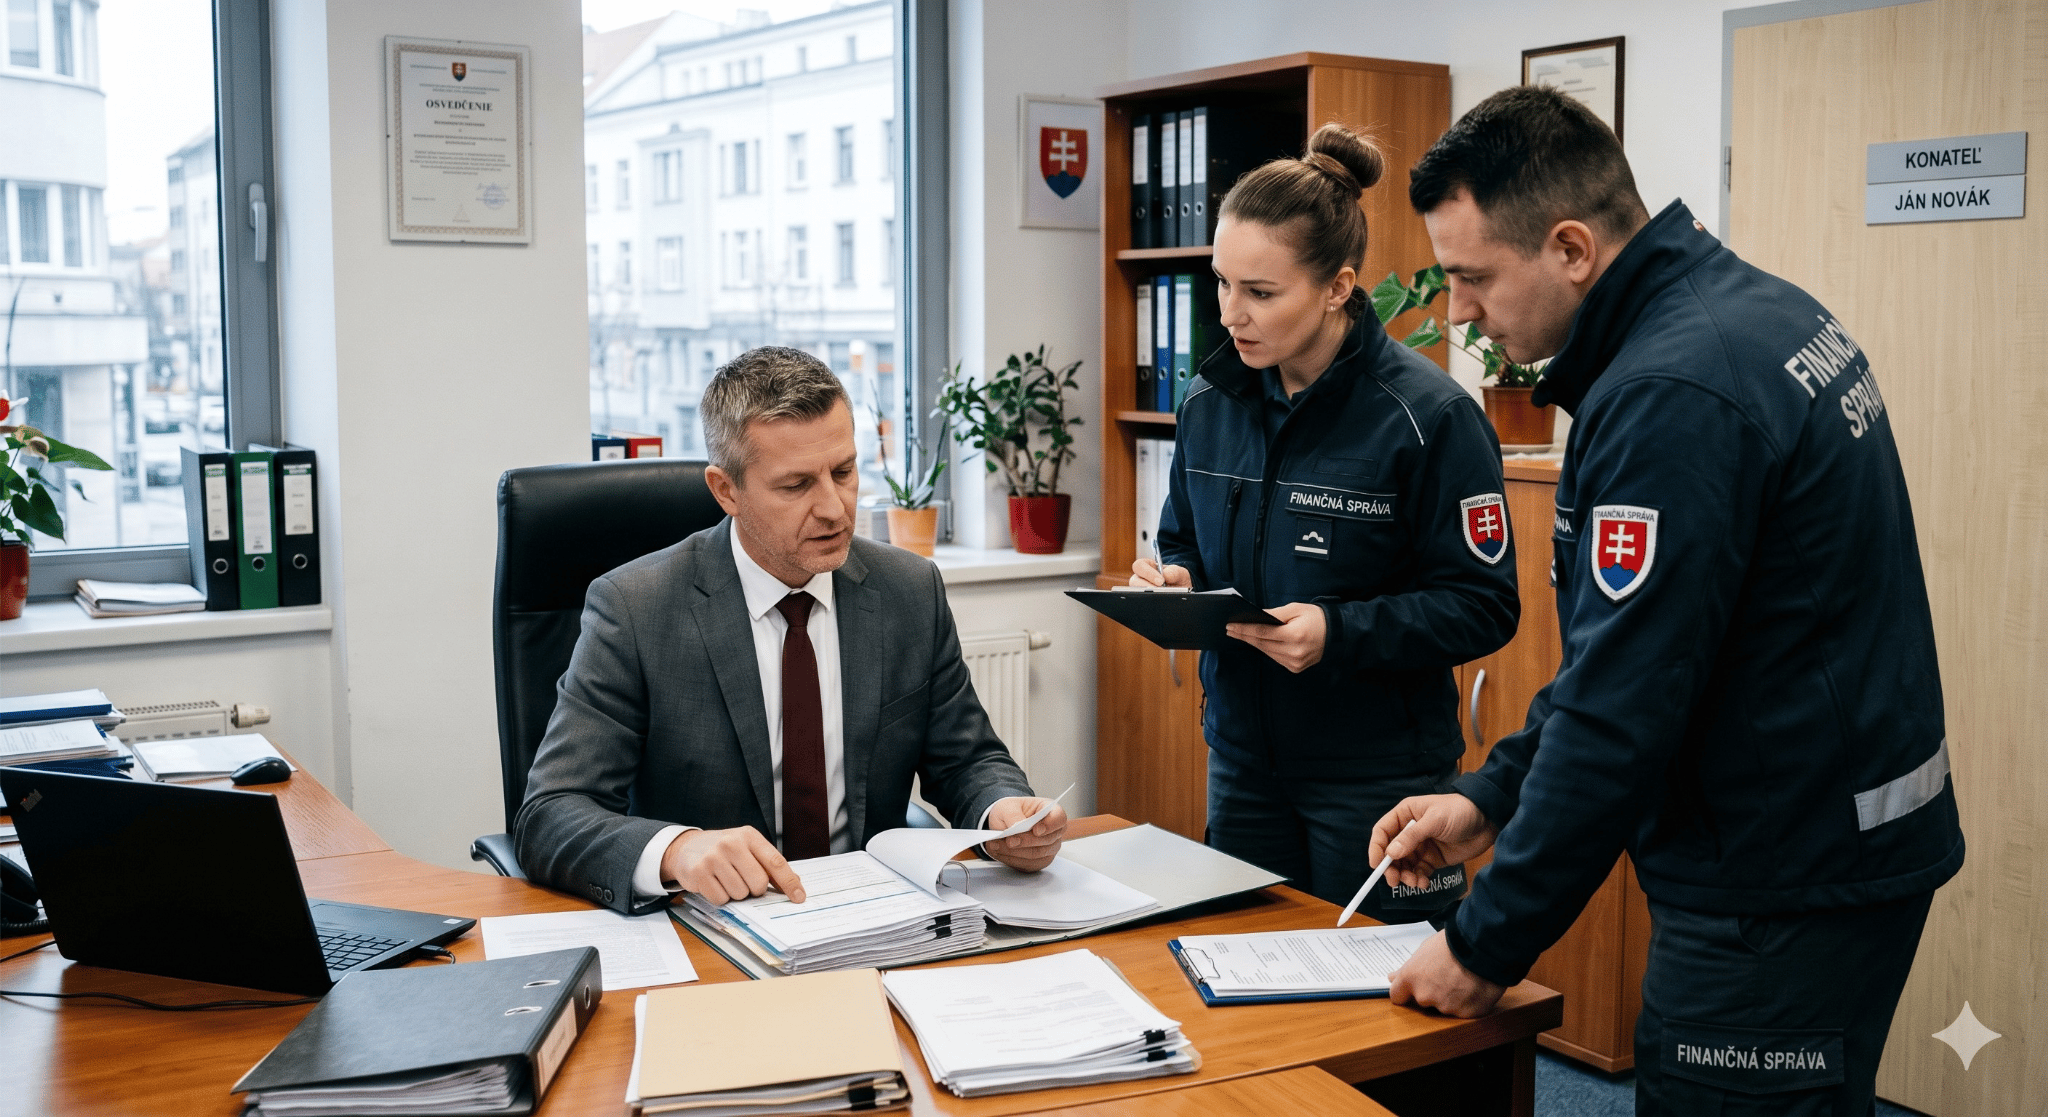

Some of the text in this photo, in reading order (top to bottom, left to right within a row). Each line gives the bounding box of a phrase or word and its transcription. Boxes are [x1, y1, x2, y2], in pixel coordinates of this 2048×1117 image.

[426, 100, 493, 111] OSVEDČENIE
[1905, 147, 1982, 169] KONATEĽ
[1895, 185, 1991, 211] JÁN NOVÁK
[1290, 492, 1391, 515] FINANČNÁ SPRÁVA
[1677, 1044, 1826, 1070] FINANČNÁ SPRÁVA
